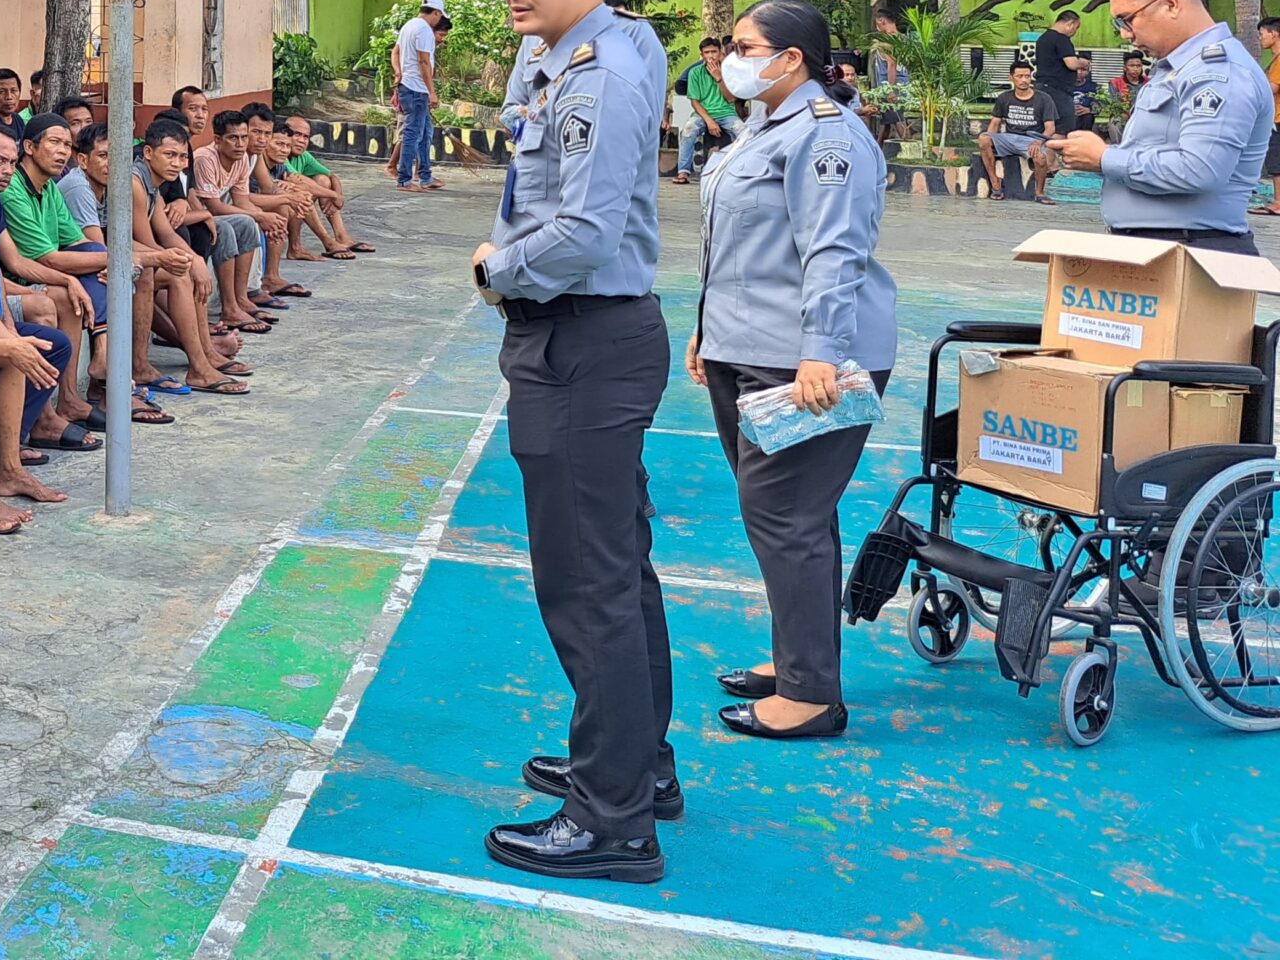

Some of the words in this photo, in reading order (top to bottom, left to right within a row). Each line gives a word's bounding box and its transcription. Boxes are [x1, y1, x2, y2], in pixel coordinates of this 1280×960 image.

[1061, 285, 1159, 319] SANBE
[1070, 325, 1103, 337] JAKARTA
[1105, 331, 1131, 342] BARAT
[982, 410, 1078, 452] SANBE
[991, 449, 1025, 461] JAKARTA
[1027, 455, 1052, 466] BARAT
